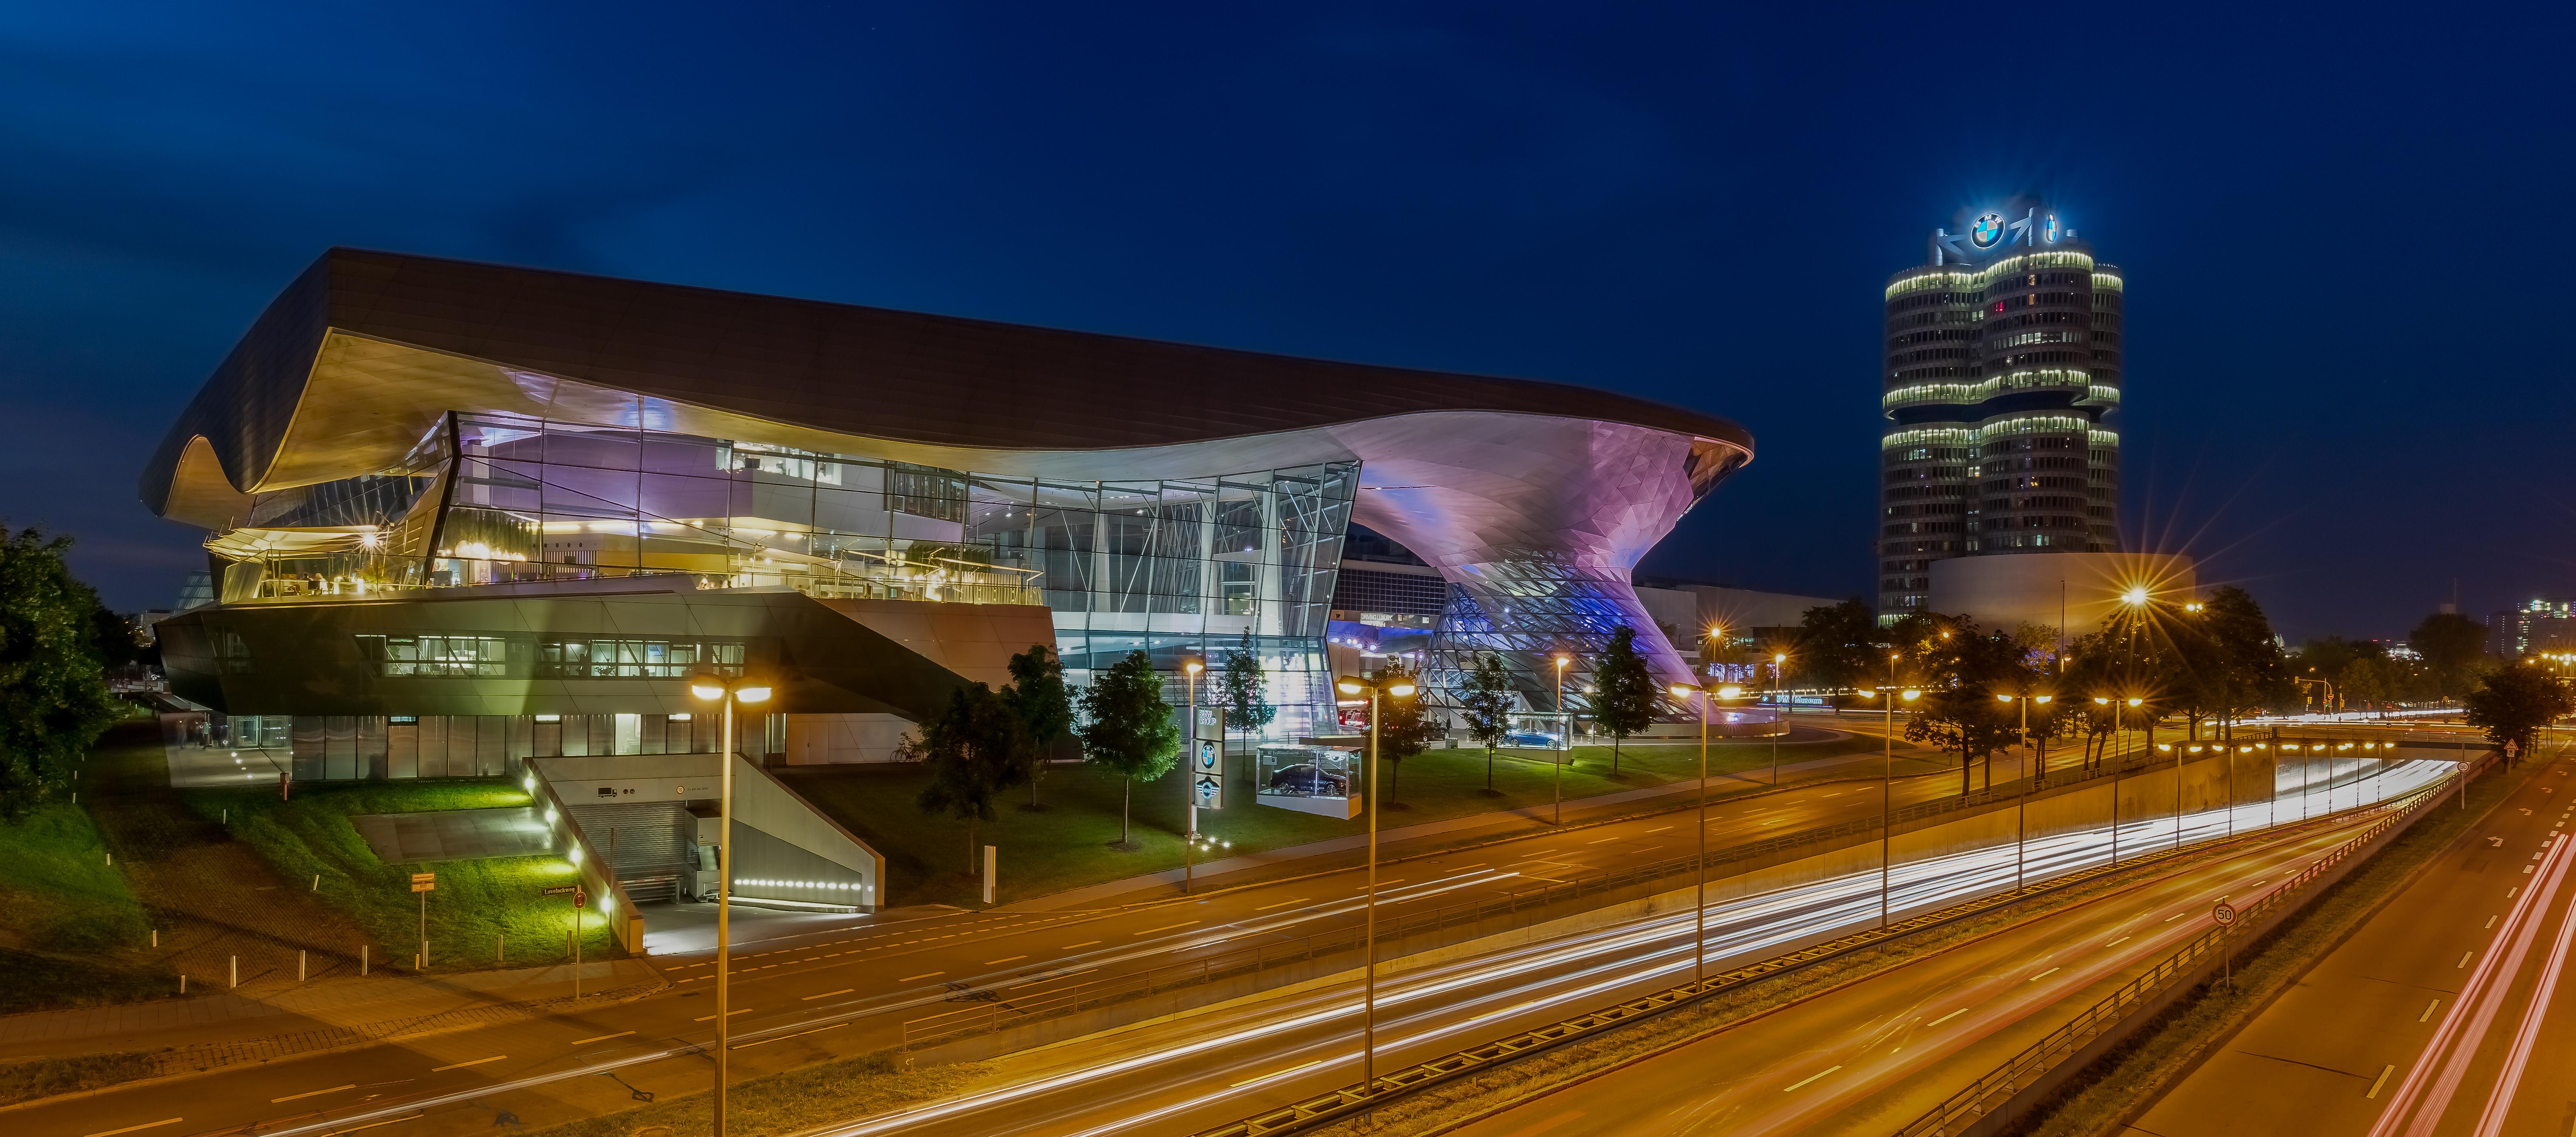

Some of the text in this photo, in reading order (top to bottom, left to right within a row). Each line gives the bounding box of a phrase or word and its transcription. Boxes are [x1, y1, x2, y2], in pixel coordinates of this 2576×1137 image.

[1975, 214, 2002, 228] BMW
[1795, 696, 1823, 704] Museum
[1198, 717, 1216, 725] GROUP
[1202, 746, 1214, 754] BMW
[2218, 909, 2232, 920] 50
